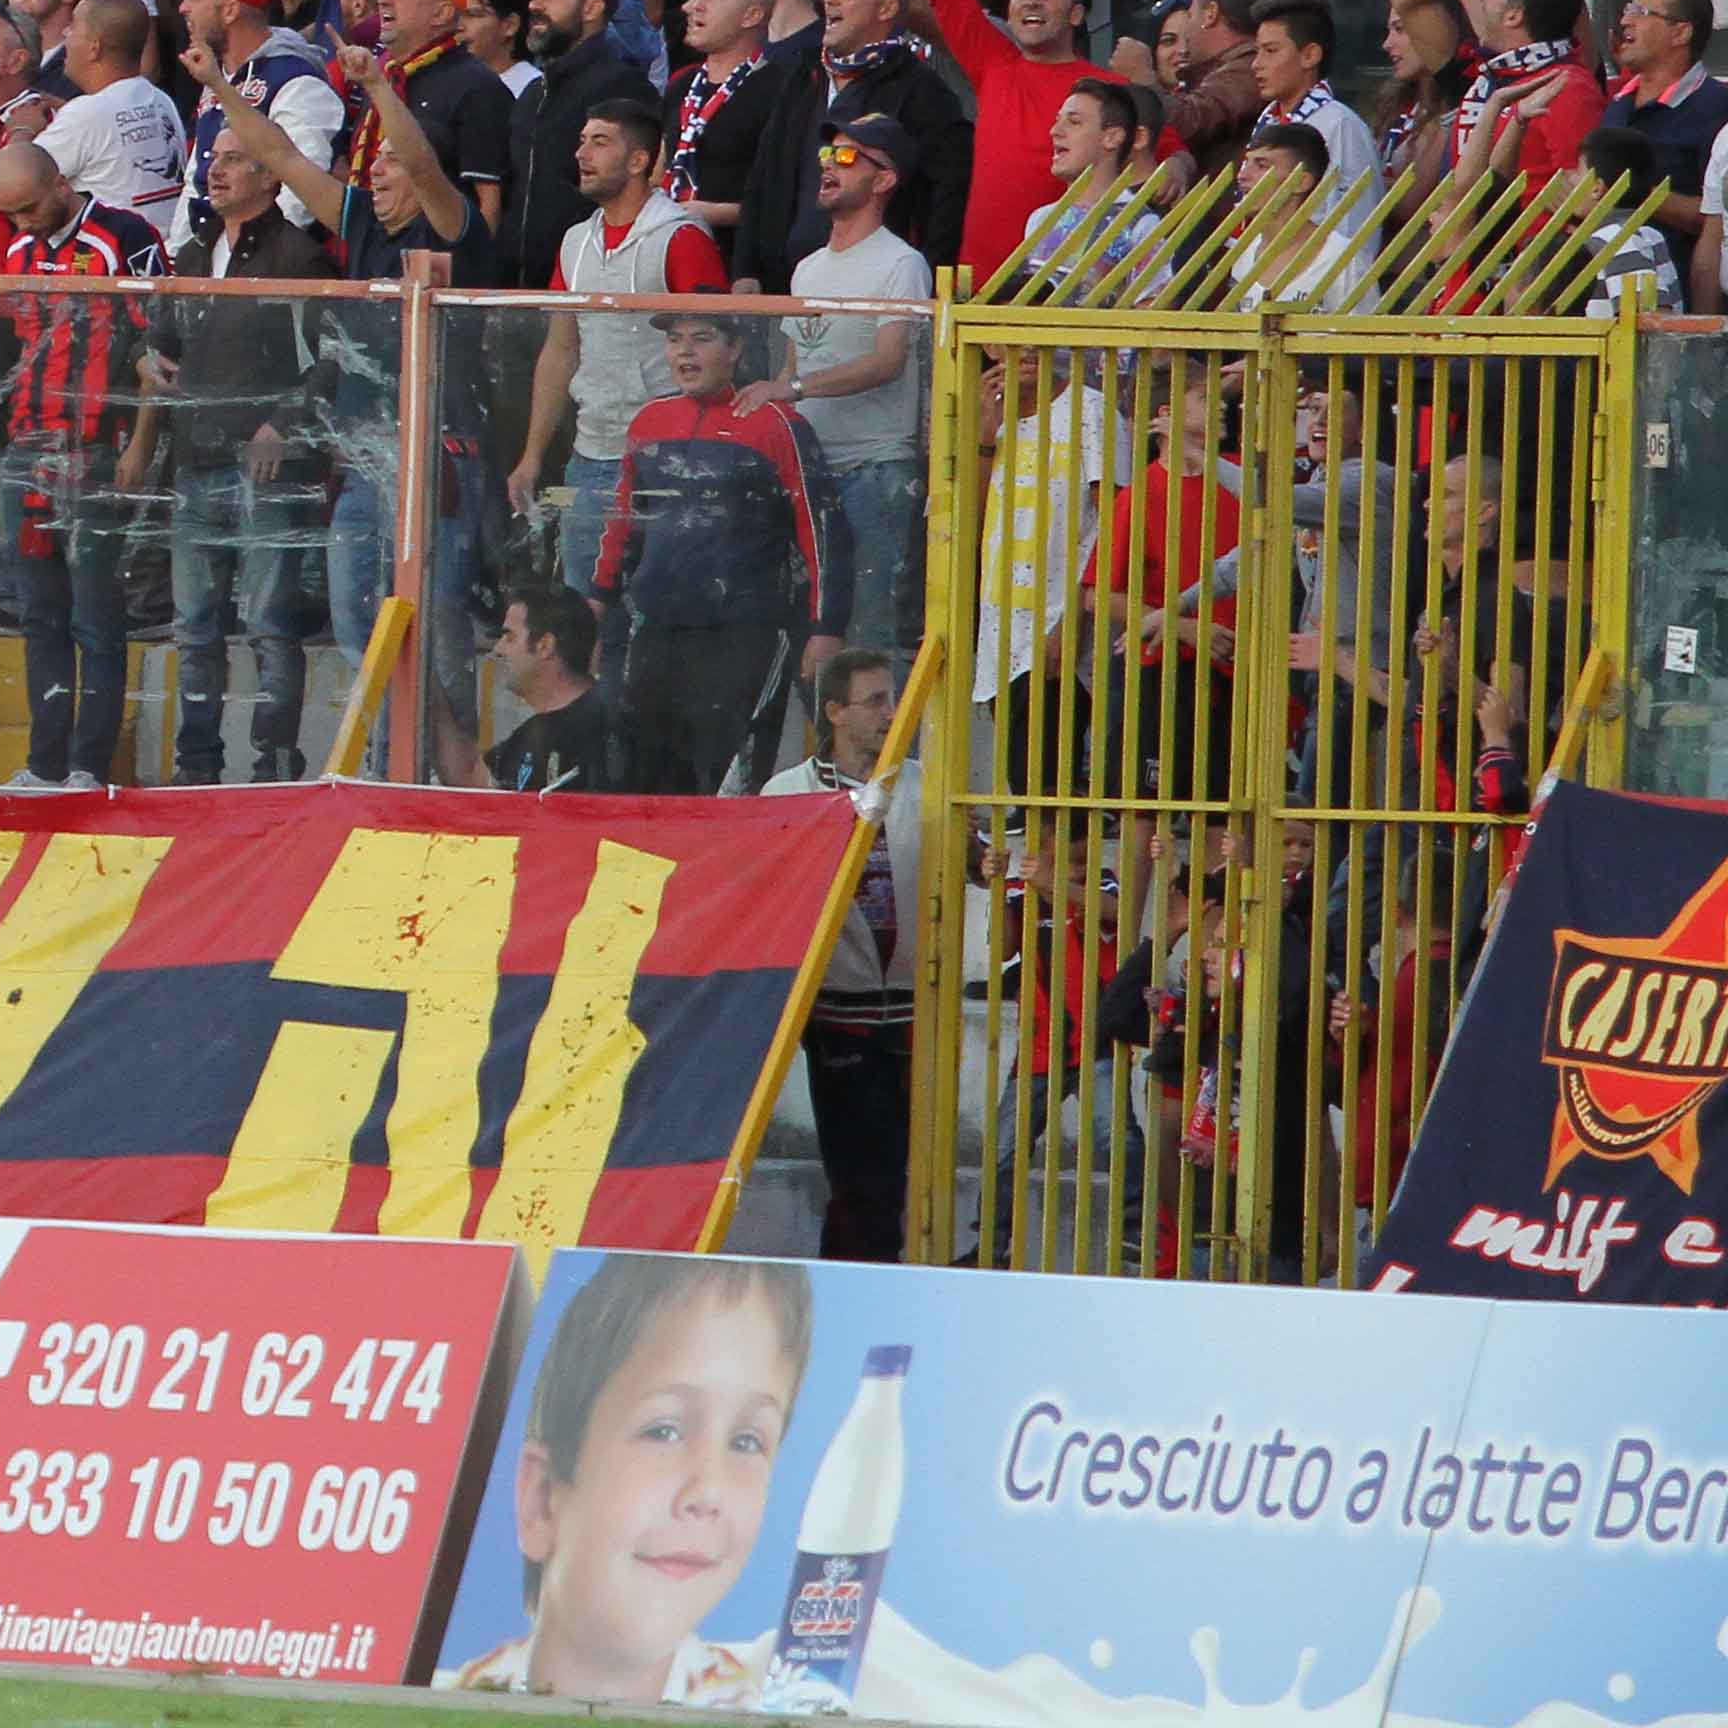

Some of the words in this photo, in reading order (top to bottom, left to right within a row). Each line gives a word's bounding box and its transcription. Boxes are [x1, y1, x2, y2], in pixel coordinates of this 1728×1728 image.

[26, 1321, 146, 1410] 320
[148, 1326, 231, 1414] 21
[240, 1332, 326, 1419] 62
[329, 1338, 451, 1425] 474
[126, 1456, 201, 1543] 10
[208, 1462, 293, 1548] 50
[296, 1468, 418, 1556] 606
[1002, 1400, 1335, 1525] Cresciuto
[1344, 1451, 1387, 1525] a
[1401, 1426, 1582, 1539] latte
[792, 1596, 862, 1624] BERNA
